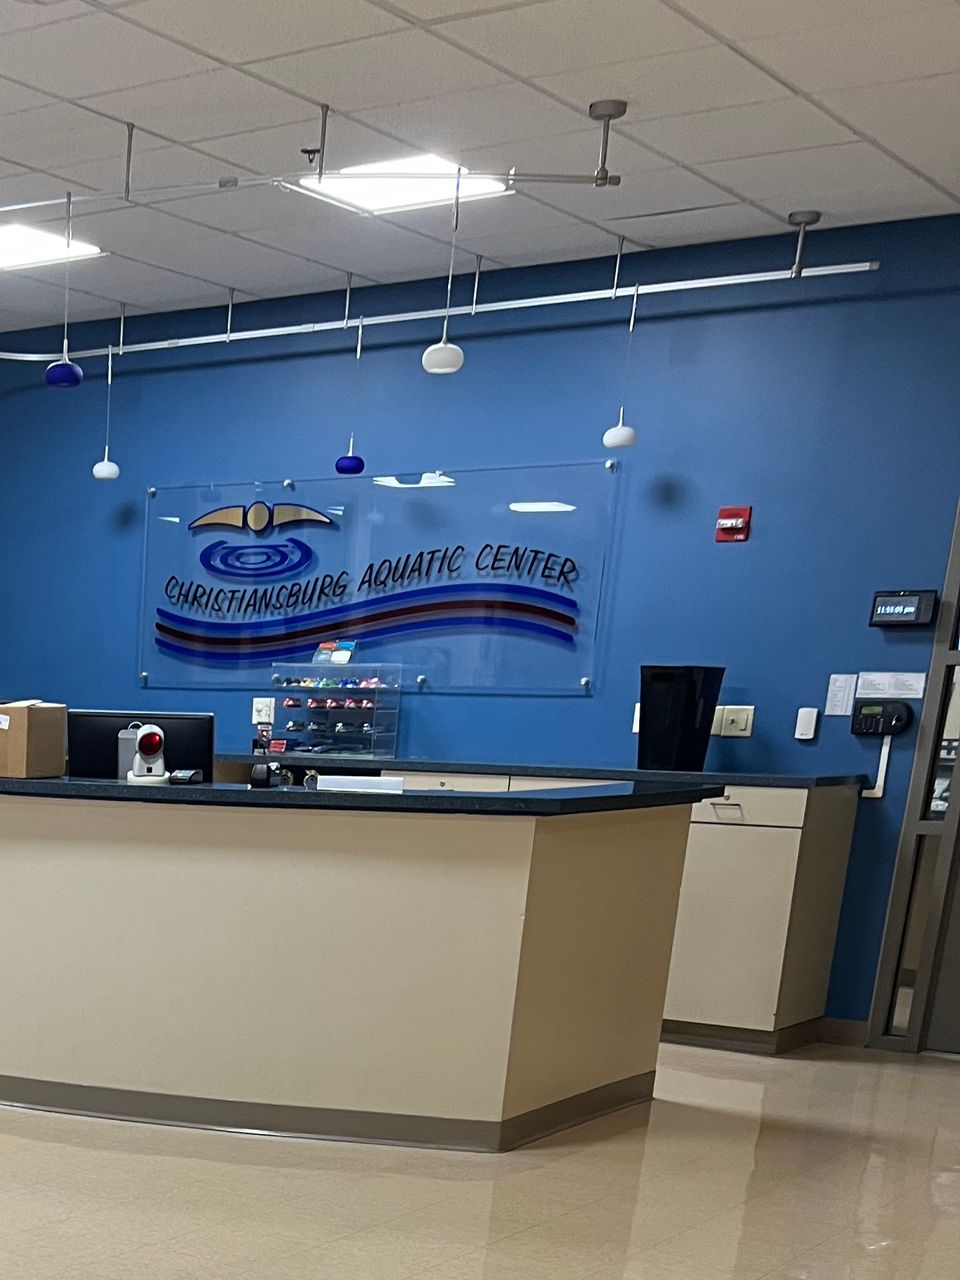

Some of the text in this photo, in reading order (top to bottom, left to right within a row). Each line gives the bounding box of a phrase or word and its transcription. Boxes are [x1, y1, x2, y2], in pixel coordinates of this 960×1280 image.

[164, 543, 577, 614] CHRISTIANSBURG AQUATIC CENTER
